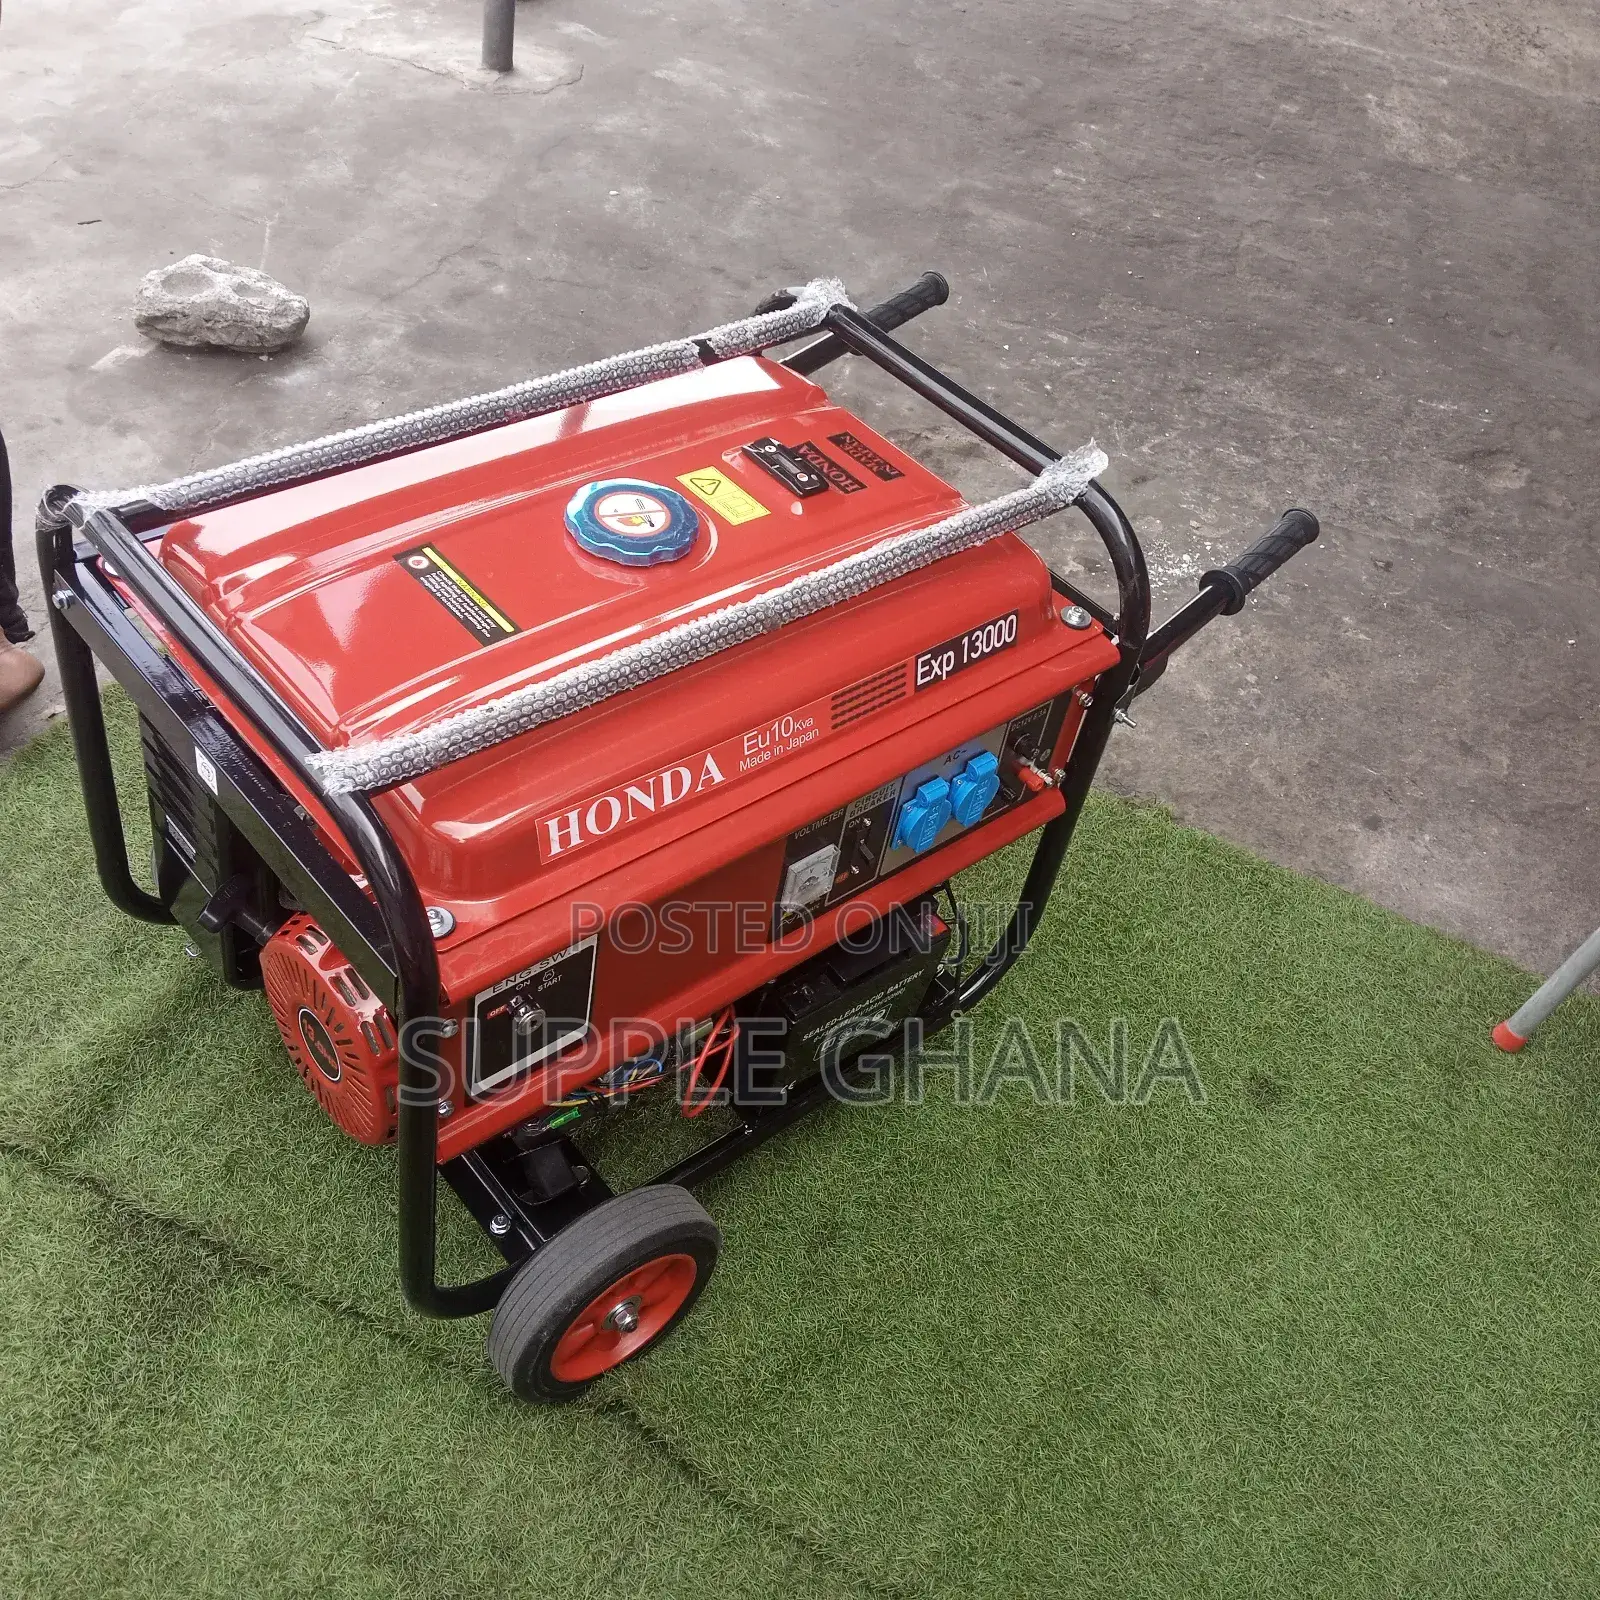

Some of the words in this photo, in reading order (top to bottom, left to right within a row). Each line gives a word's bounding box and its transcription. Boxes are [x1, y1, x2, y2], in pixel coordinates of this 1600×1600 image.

[799, 444, 862, 492] HONDA
[437, 570, 453, 585] Check
[451, 585, 463, 595] that
[461, 594, 475, 606] there
[486, 618, 498, 628] any
[456, 578, 489, 608] WARNING
[915, 653, 956, 687] Exp
[960, 615, 1018, 661] 13000
[738, 751, 771, 772] Made
[773, 745, 785, 758] in
[786, 729, 820, 754] Japan
[543, 753, 727, 857] HONDA
[849, 790, 896, 818] BREAKER
[854, 783, 896, 809] CIRCUIT
[794, 808, 845, 840] VOLTMETER
[848, 818, 861, 828] ON
[515, 979, 531, 991] ON
[537, 974, 563, 992] START
[886, 968, 925, 994] BATTERY
[489, 1005, 506, 1017] OFF
